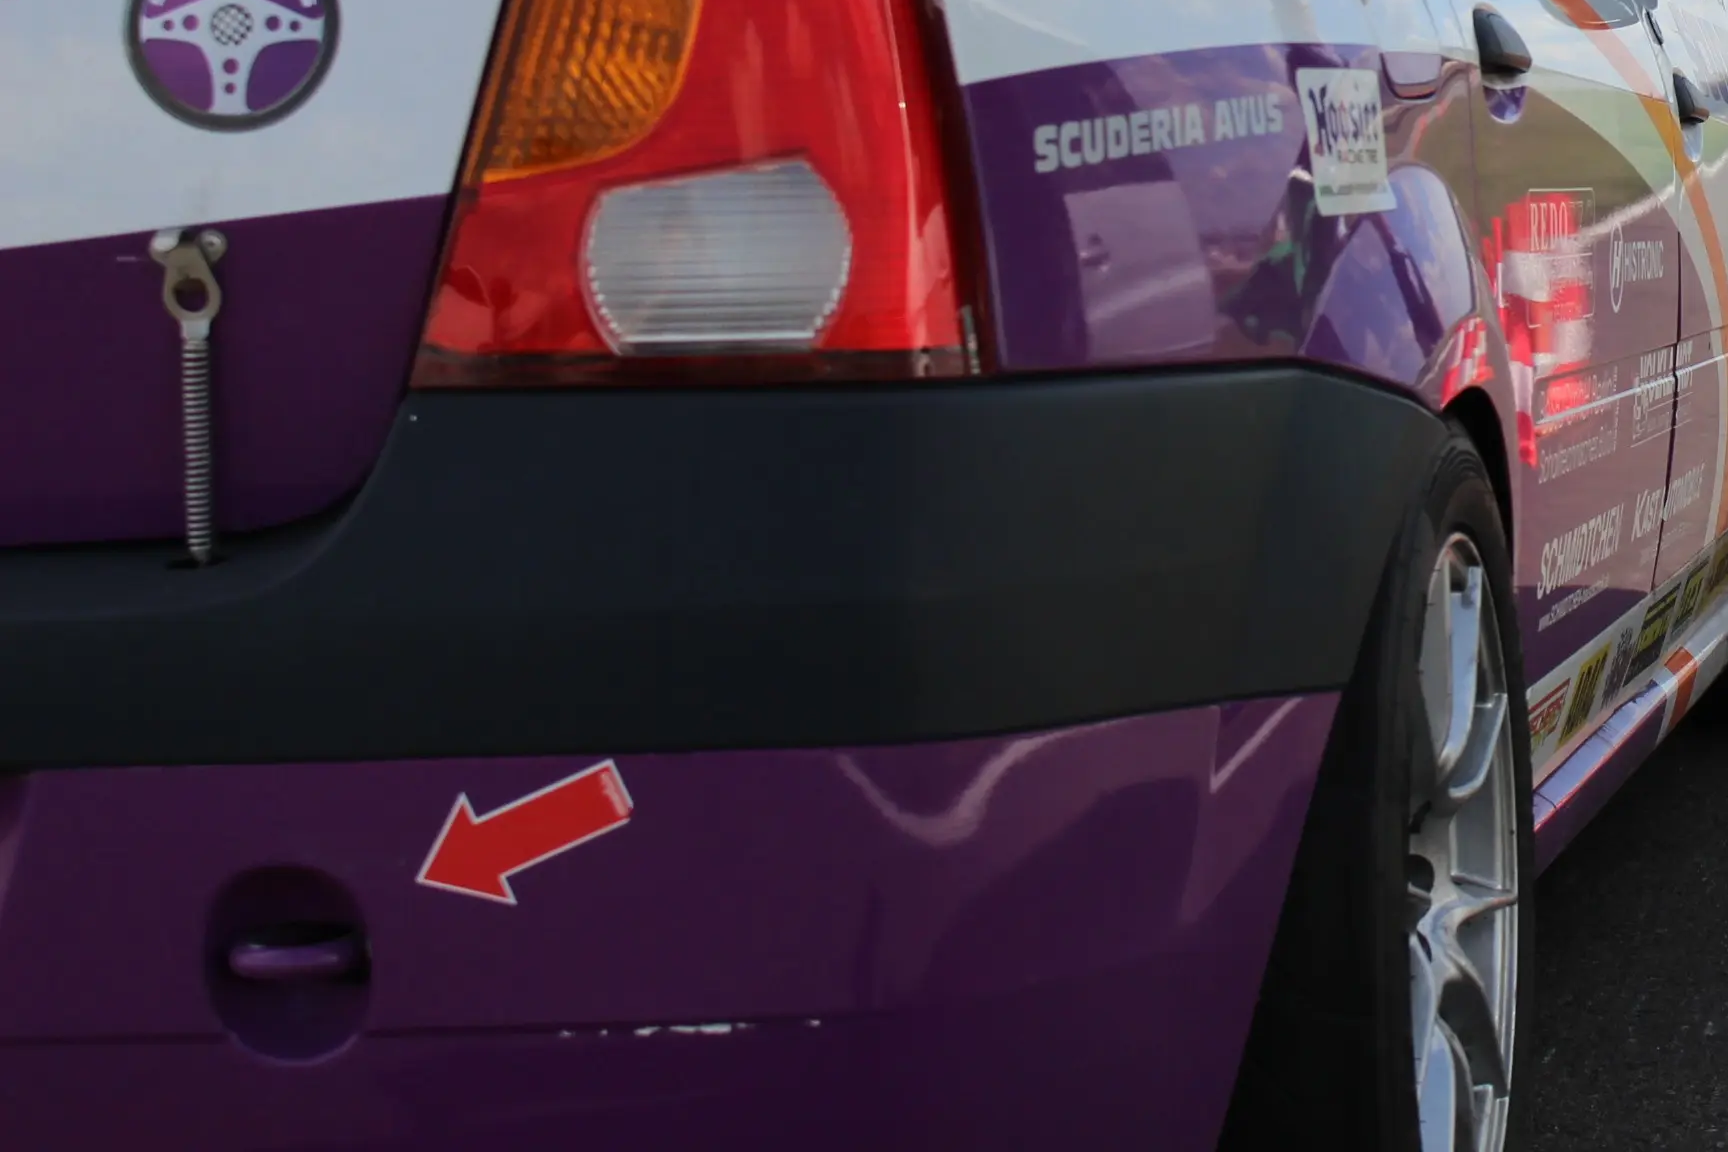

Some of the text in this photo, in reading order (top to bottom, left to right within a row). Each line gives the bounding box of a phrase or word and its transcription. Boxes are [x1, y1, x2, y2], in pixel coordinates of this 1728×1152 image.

[1033, 92, 1285, 173] SCUDERIA AVUS
[1308, 83, 1379, 156] Hoosier
[1536, 502, 1624, 601] SCHMIDTCHEN
